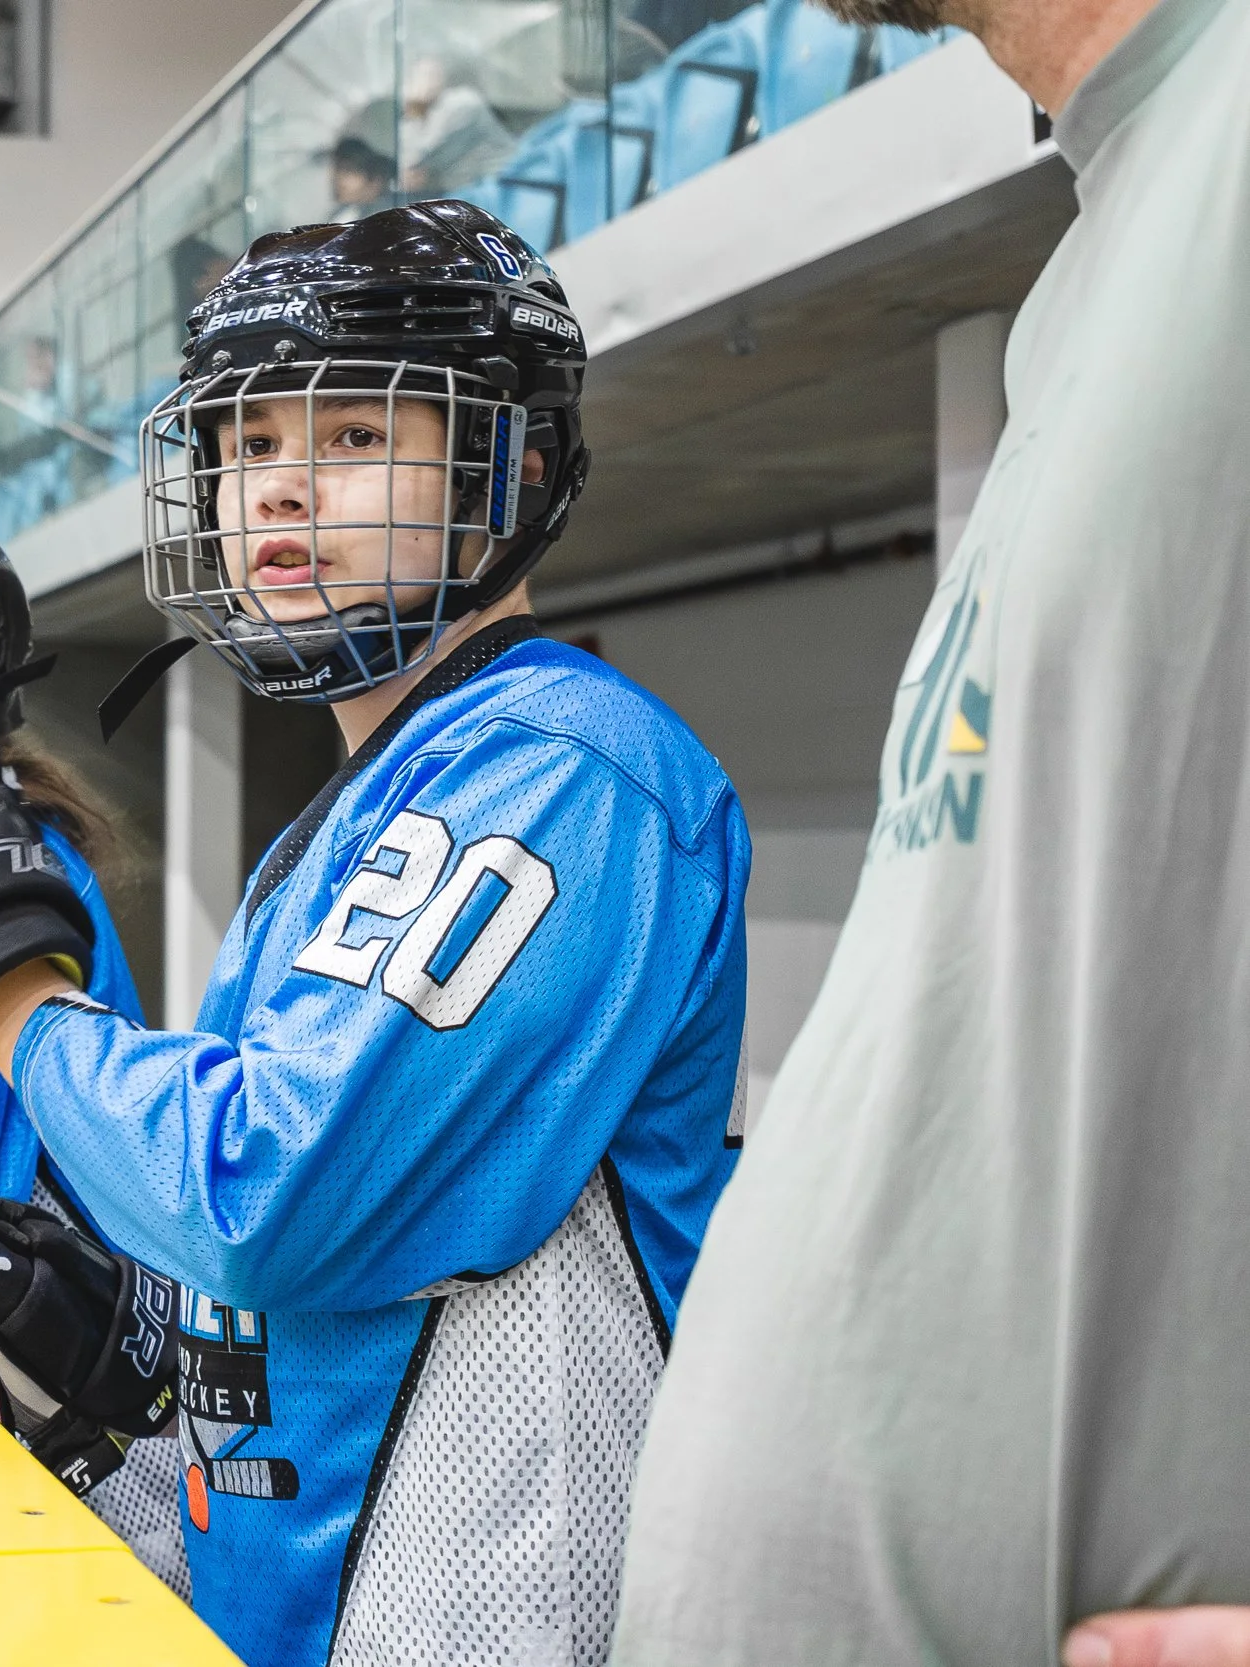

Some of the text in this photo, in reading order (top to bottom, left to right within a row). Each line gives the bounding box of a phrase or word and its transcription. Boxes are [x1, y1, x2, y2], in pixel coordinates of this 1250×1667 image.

[206, 300, 308, 332] BAUER
[513, 307, 579, 342] BAUER
[492, 415, 509, 527] BAUER
[260, 666, 332, 692] AUER
[291, 809, 559, 1032] 20
[179, 1377, 257, 1418] OCKEY
